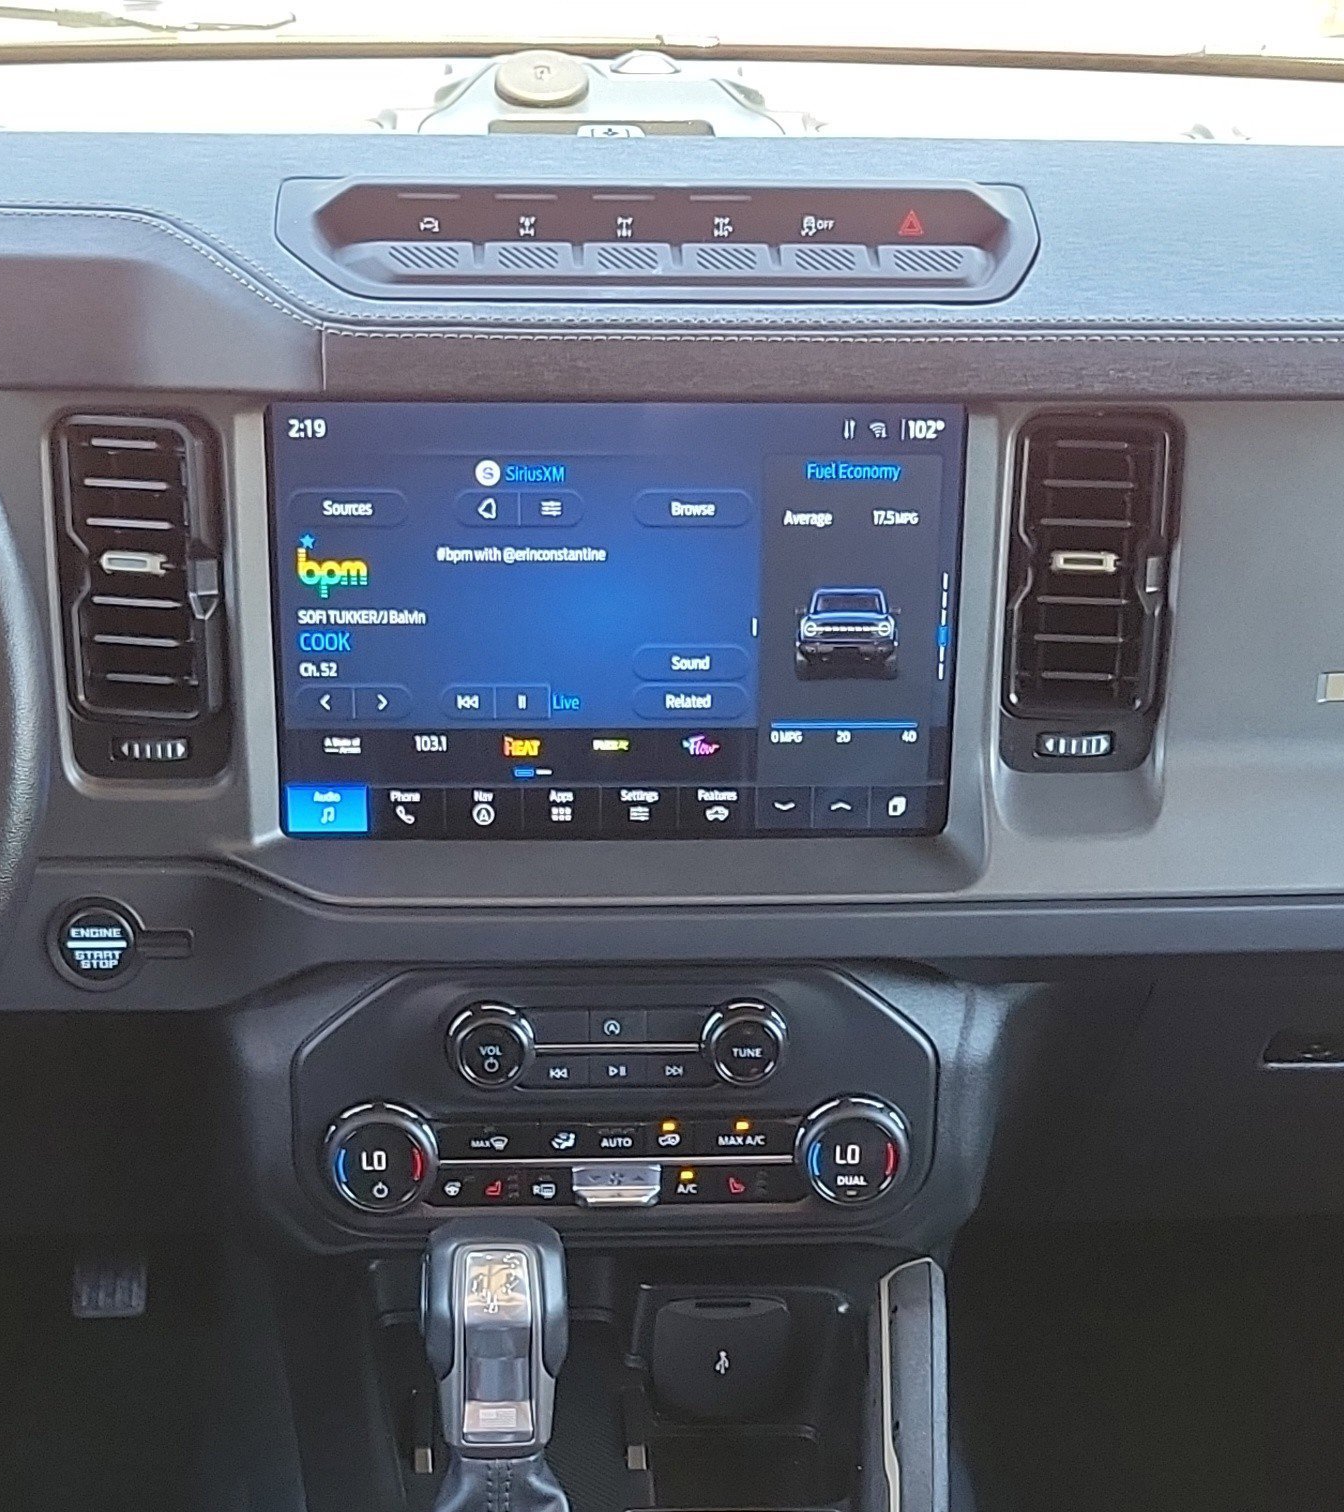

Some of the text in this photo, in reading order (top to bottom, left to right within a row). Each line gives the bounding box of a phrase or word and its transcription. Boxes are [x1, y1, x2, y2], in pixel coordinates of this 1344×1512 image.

[816, 219, 835, 231] OFF
[288, 419, 326, 438] 2:19
[506, 465, 565, 482] SiriusXM
[807, 463, 901, 482] Fuel Economy
[323, 501, 373, 516] Sources
[671, 502, 716, 516] Browse
[783, 511, 833, 526] Average
[437, 547, 606, 563] #bpm with @erinconstantine
[297, 548, 368, 598] bpm
[297, 610, 426, 625] SOFI TUKKER/J Balvin
[299, 632, 351, 652] COOK
[299, 663, 338, 677] Ch. 52
[671, 656, 710, 671] Sound
[553, 694, 579, 710] Live
[665, 693, 712, 709] Related
[414, 735, 447, 752] 103.1
[770, 730, 803, 744] 0 MPG
[836, 731, 851, 743] 20
[901, 731, 918, 743] 40
[389, 790, 421, 803] Phone
[473, 790, 493, 803] Nav
[549, 790, 574, 803] Apps
[620, 790, 659, 804] Settings
[697, 790, 737, 803] Features
[70, 928, 122, 938] ENGINE
[75, 951, 122, 960] START
[80, 960, 118, 969] STOP
[479, 1045, 502, 1057] VOL
[732, 1047, 762, 1058] TUNE
[471, 1138, 491, 1148] MAX
[601, 1137, 633, 1148] AUTO
[718, 1135, 766, 1146] MAX A/C
[837, 1176, 866, 1187] DUAL
[677, 1183, 697, 1194] A/C
